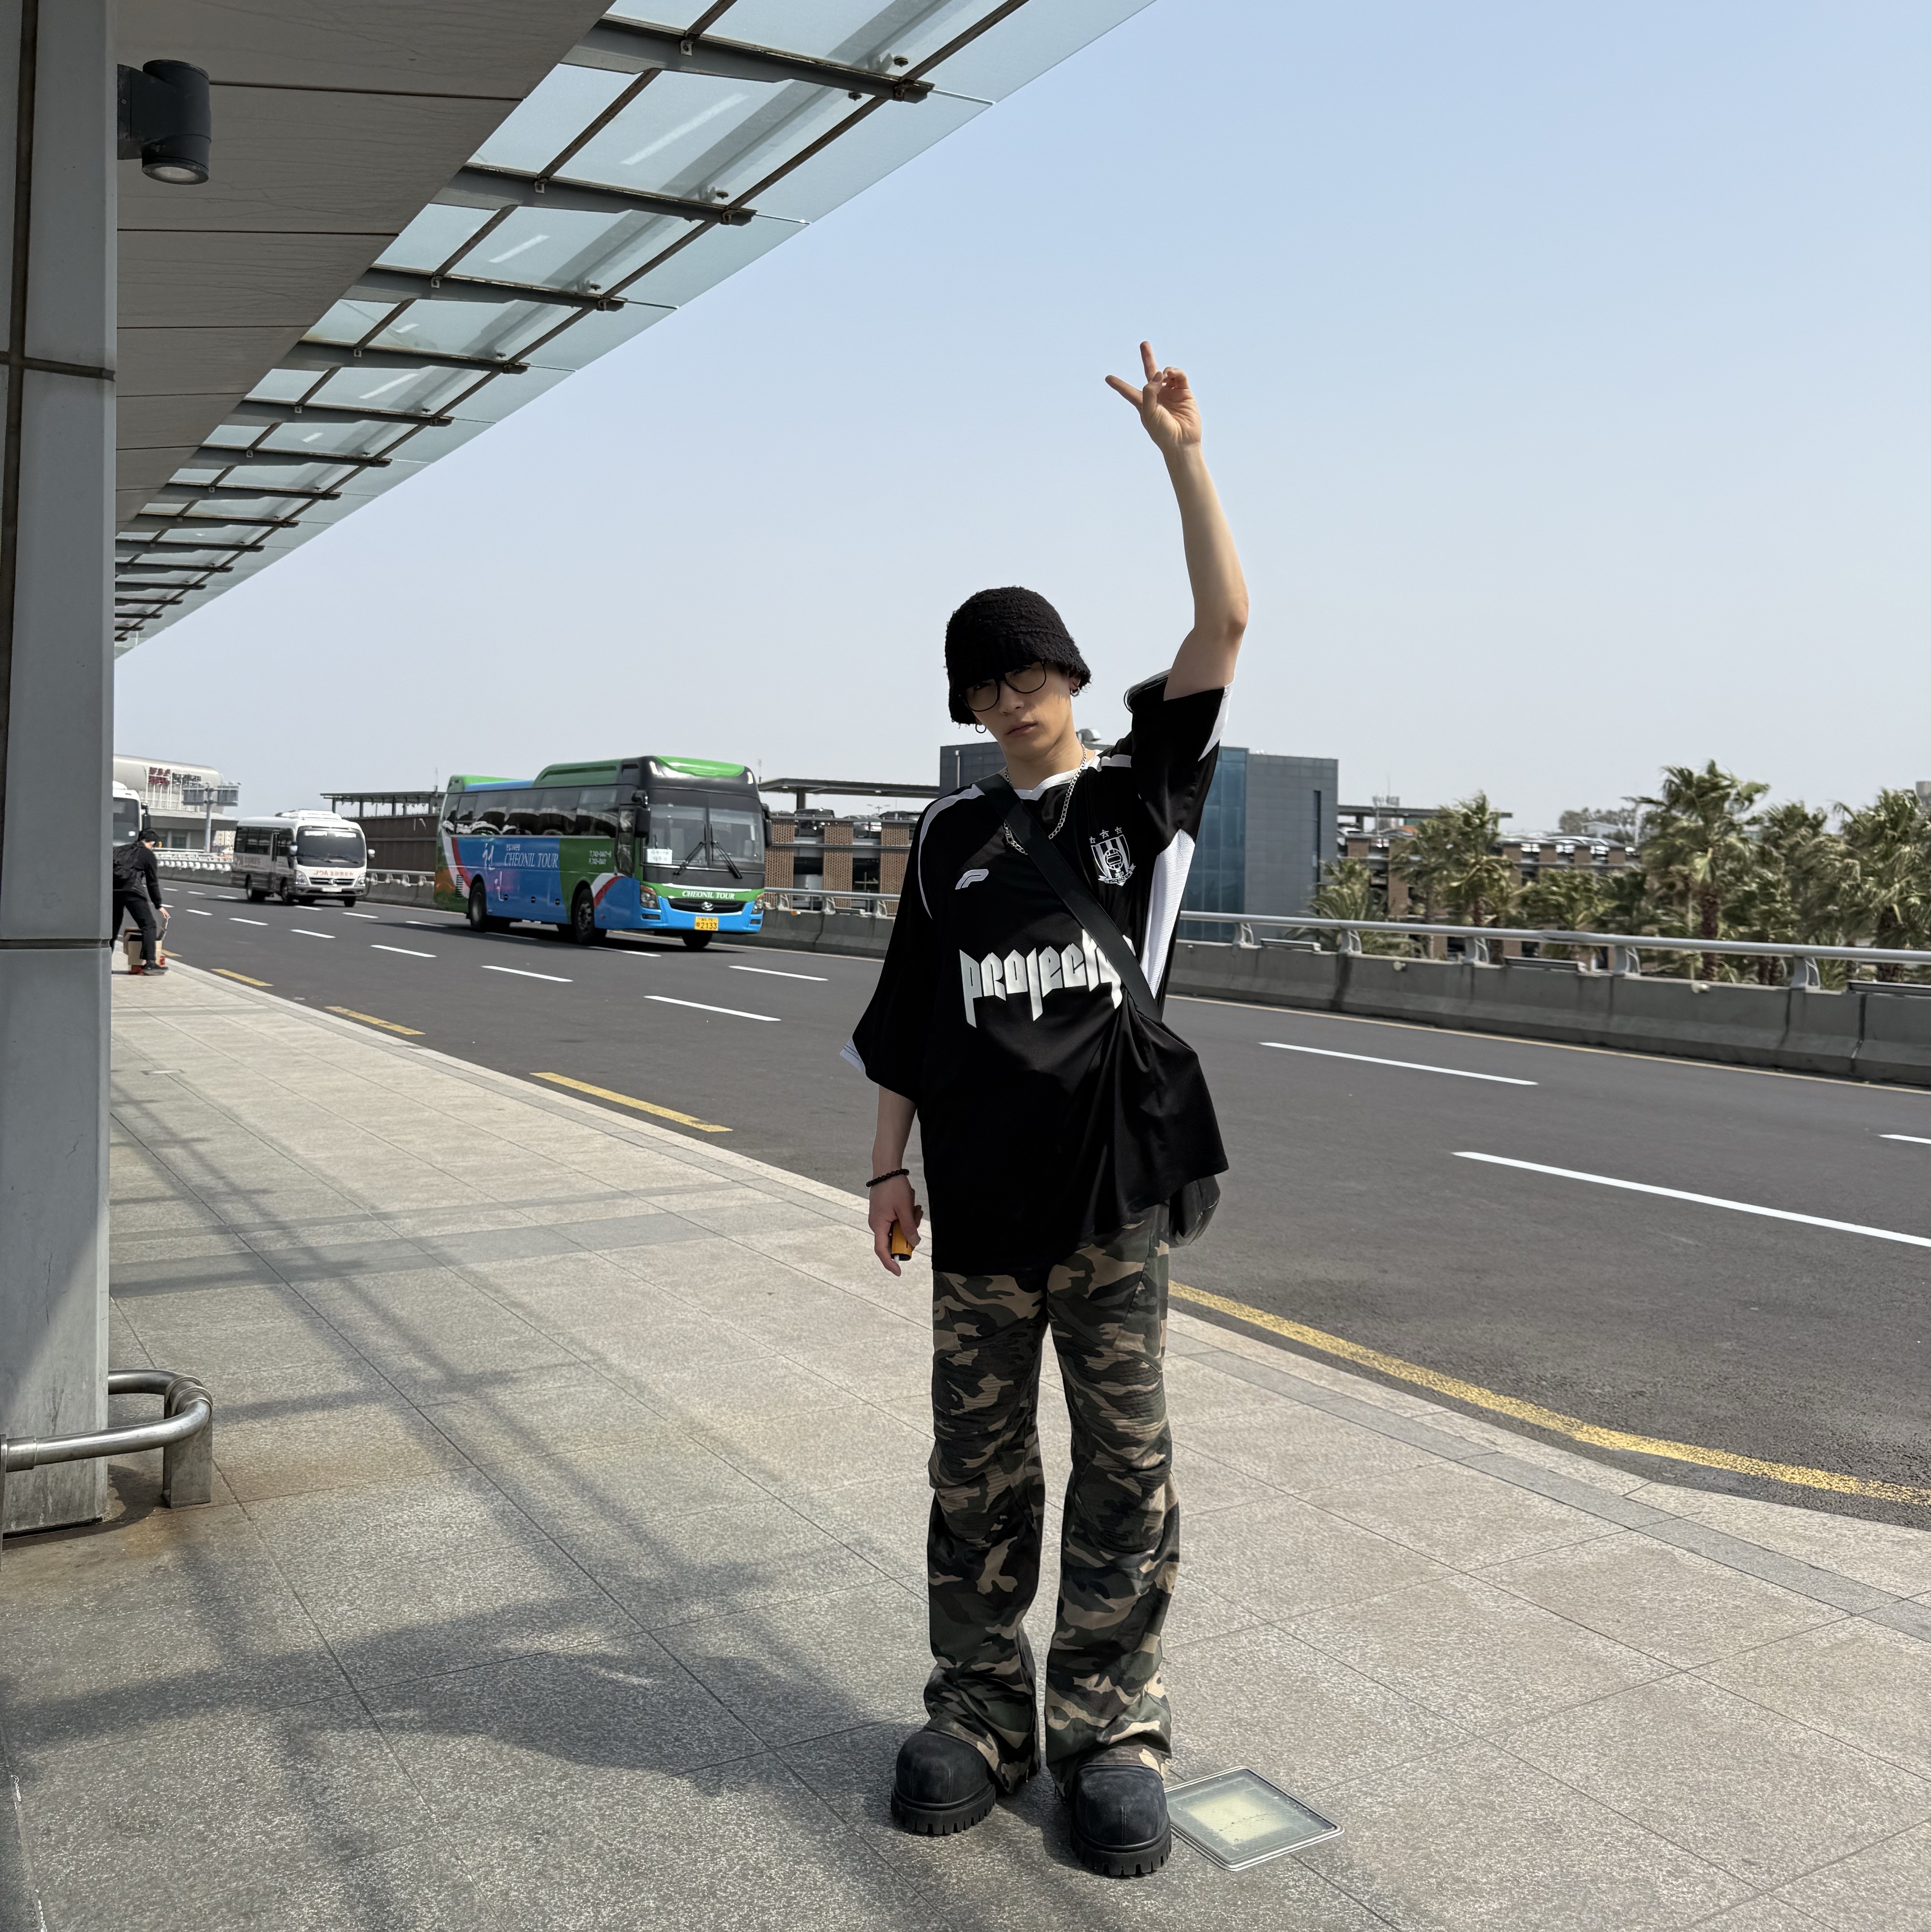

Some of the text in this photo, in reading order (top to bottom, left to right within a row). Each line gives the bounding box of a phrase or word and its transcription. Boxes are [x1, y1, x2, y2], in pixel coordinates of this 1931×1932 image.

[505, 852, 536, 867] CHEONIL
[537, 853, 559, 868] TOUR
[682, 890, 735, 900] CHEONIL TOUR
